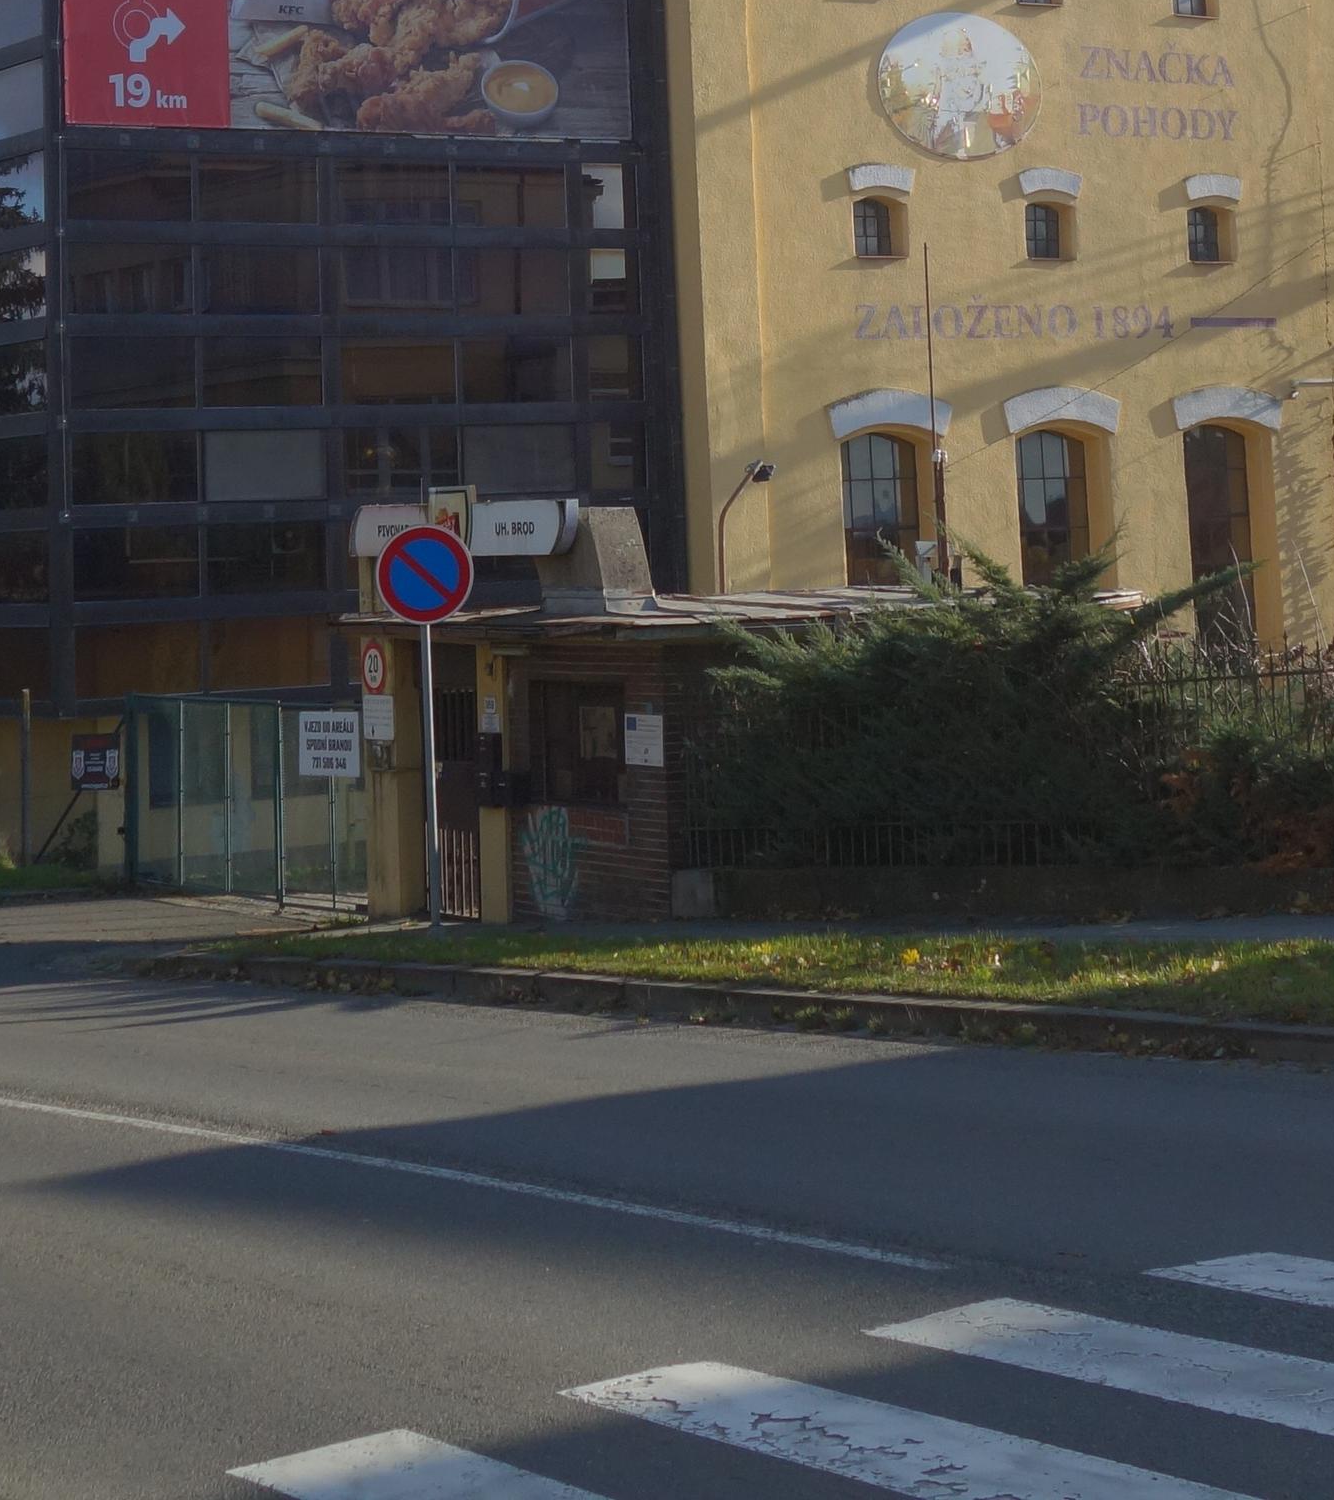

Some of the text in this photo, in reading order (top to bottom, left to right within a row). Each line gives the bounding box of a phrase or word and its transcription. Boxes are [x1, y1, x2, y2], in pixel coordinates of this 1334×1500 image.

[278, 4, 305, 15] KFC
[1079, 40, 1235, 88] ZNAČKA
[108, 72, 188, 108] 19 km
[1077, 102, 1239, 141] POHODY
[853, 293, 1175, 340] ZALOŽENO 1894
[377, 521, 535, 538] PIVOVA UH. BROD
[368, 653, 379, 674] 20
[331, 718, 354, 733] AREÁLU
[328, 739, 352, 752] BRANOU
